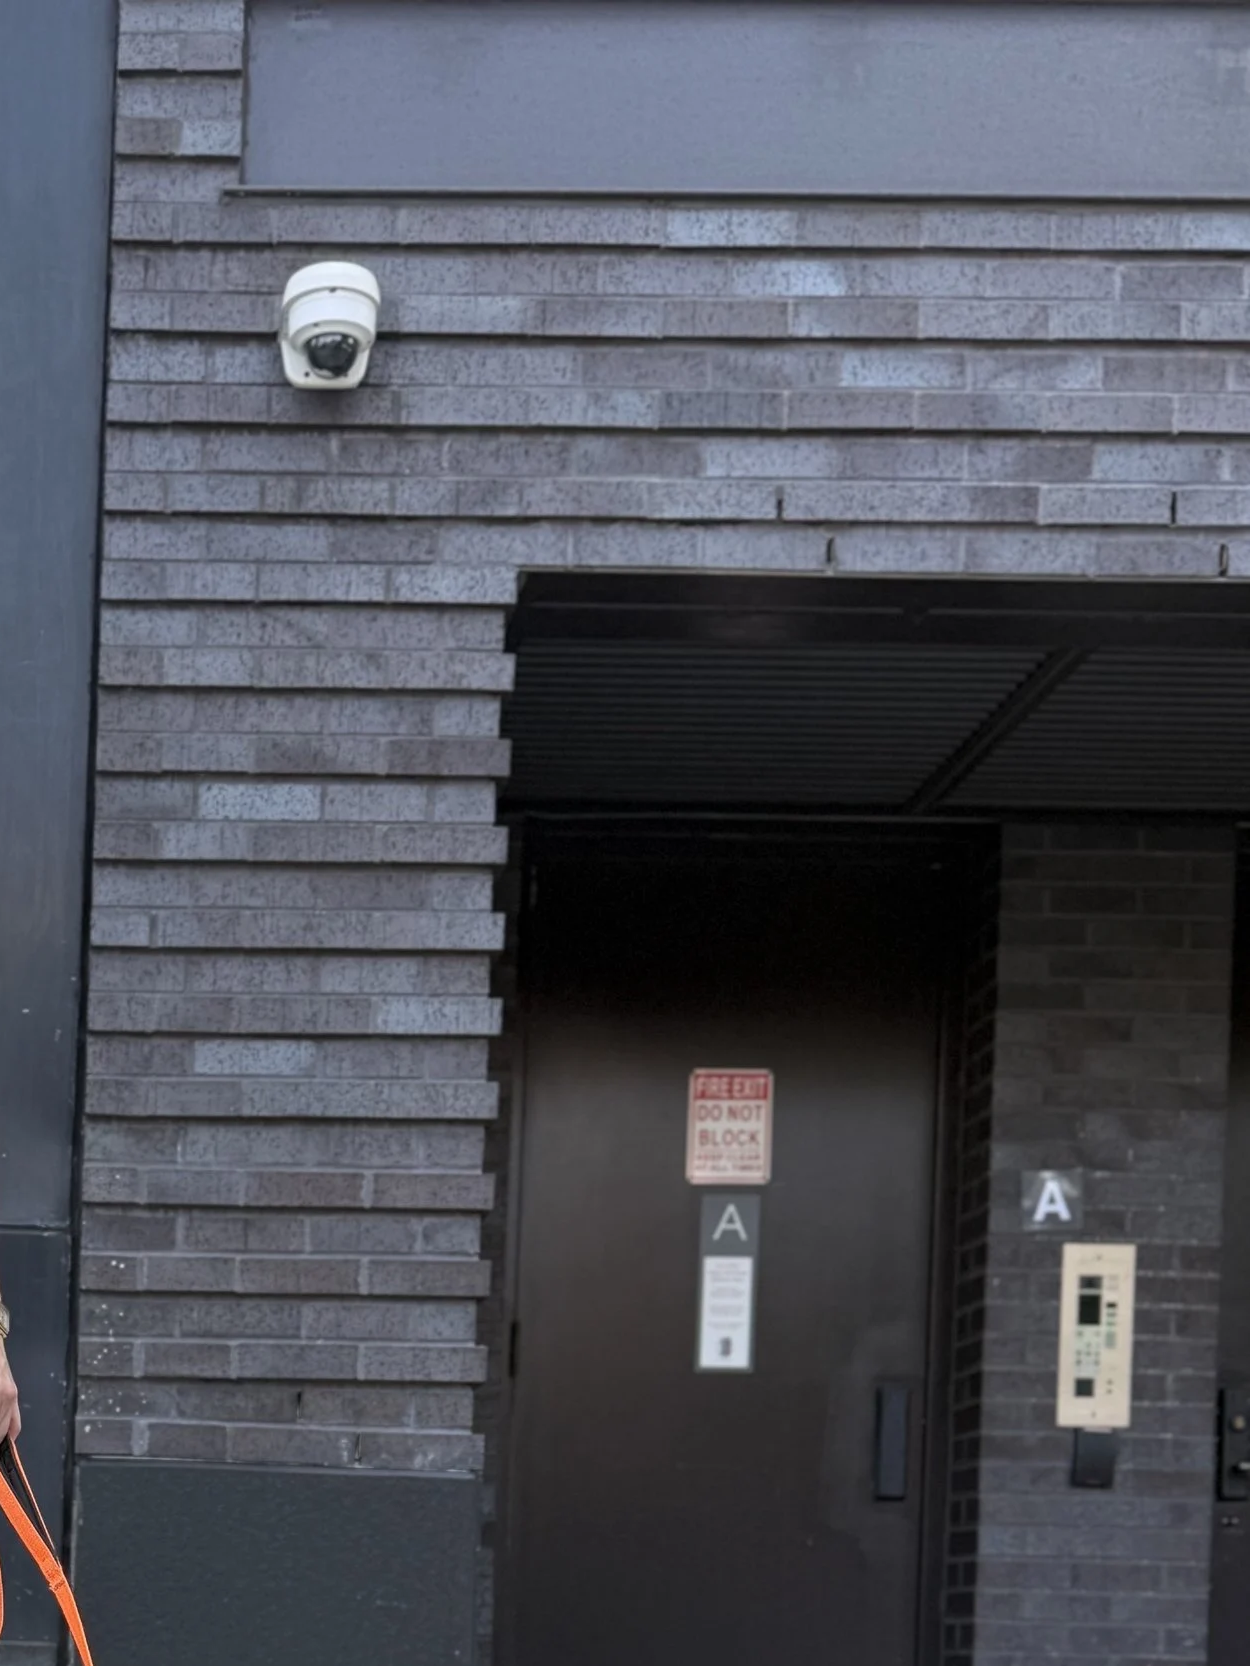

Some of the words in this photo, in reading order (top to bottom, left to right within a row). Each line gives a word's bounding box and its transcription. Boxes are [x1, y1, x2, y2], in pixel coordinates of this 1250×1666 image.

[697, 1076, 729, 1098] FIRE
[733, 1076, 766, 1098] EXIT
[698, 1104, 723, 1121] DO
[727, 1104, 763, 1121] NOT
[698, 1129, 760, 1146] BLOCK
[1033, 1179, 1072, 1222] A
[712, 1203, 748, 1241] A
